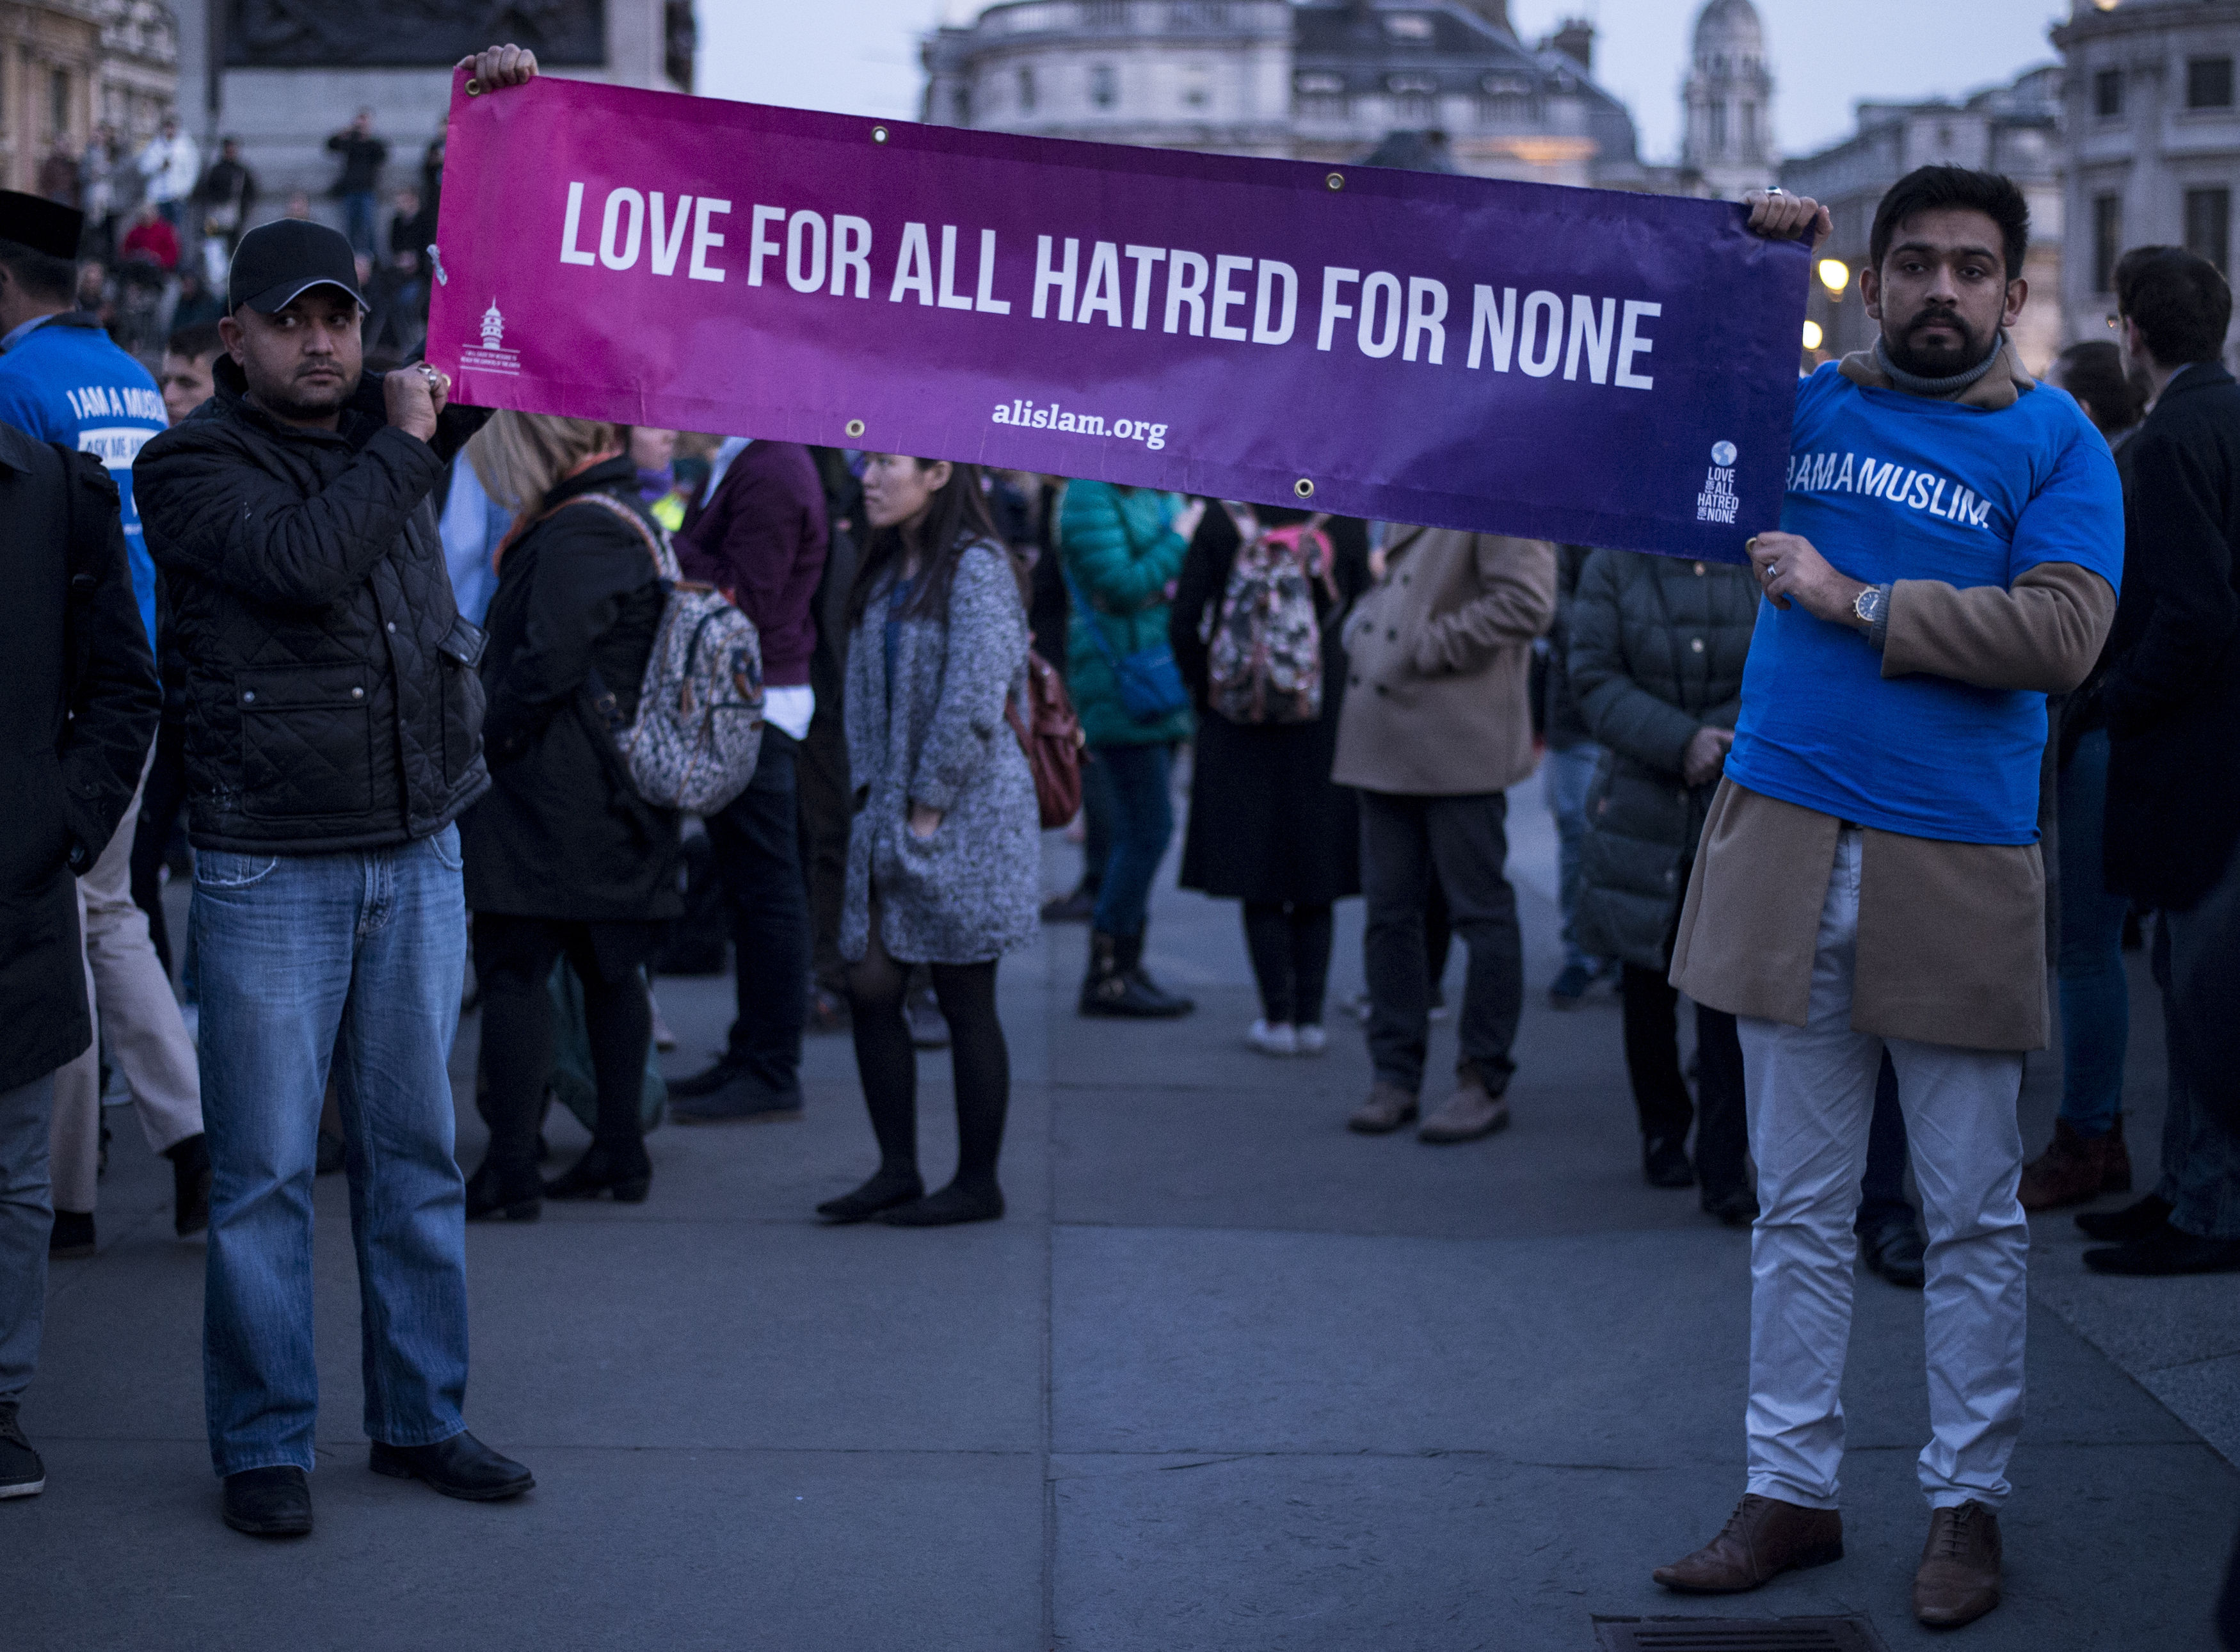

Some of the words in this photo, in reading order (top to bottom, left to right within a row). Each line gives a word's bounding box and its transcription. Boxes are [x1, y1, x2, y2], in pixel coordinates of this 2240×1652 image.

[560, 181, 731, 282] LOVE
[748, 204, 872, 299] FOR
[889, 222, 1011, 315] ALL
[1032, 235, 1298, 346] HATRED
[1316, 266, 1448, 365] FOR
[1467, 284, 1661, 390] NONE
[65, 389, 83, 420] I
[78, 386, 111, 419] AM
[109, 387, 125, 417] A
[122, 387, 169, 426] MUSL
[991, 399, 1169, 450] alislam.org
[1708, 466, 1736, 483] LOVE
[1792, 453, 1837, 491] AM
[1833, 452, 1854, 492] A
[1697, 492, 1740, 511] HATRED
[1705, 479, 1715, 495] FOR
[1715, 481, 1734, 496] ALL
[1697, 506, 1707, 521] FOR
[1706, 508, 1736, 524] NONE
